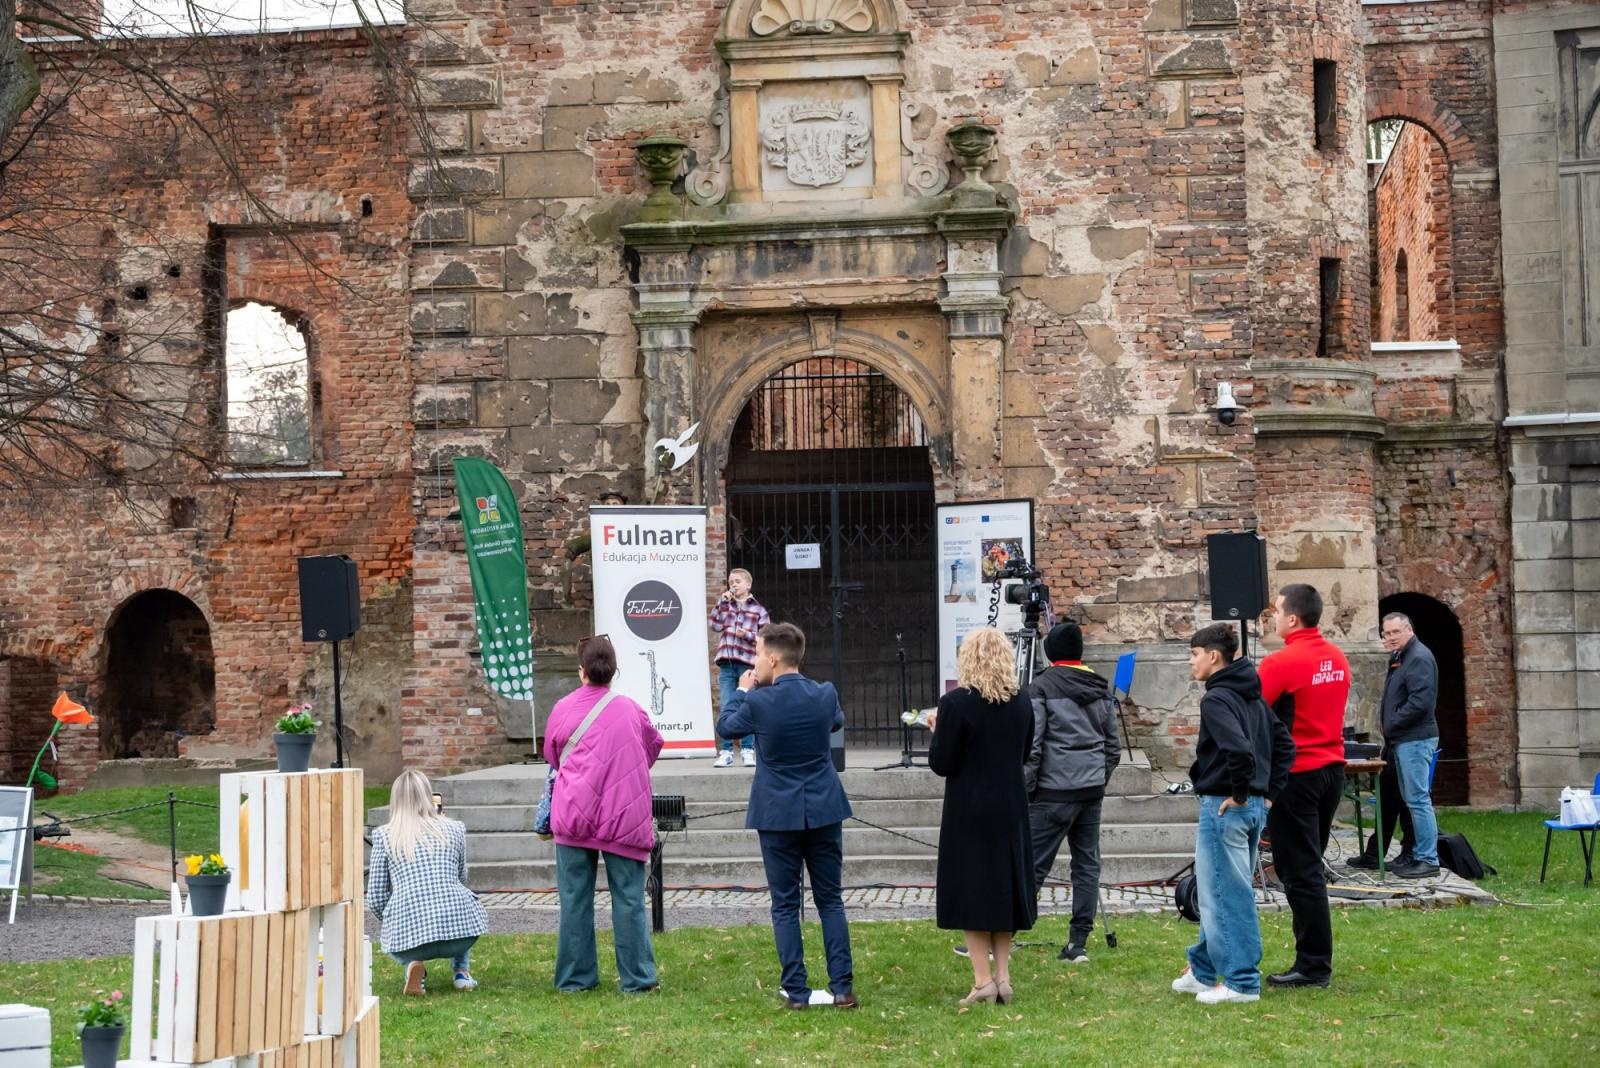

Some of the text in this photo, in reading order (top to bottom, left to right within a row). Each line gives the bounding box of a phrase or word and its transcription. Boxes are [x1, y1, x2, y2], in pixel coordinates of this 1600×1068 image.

[603, 524, 697, 546] Fulnart
[602, 552, 699, 564] Edukacja Muzyczna
[651, 721, 693, 732] ulnart.pl
